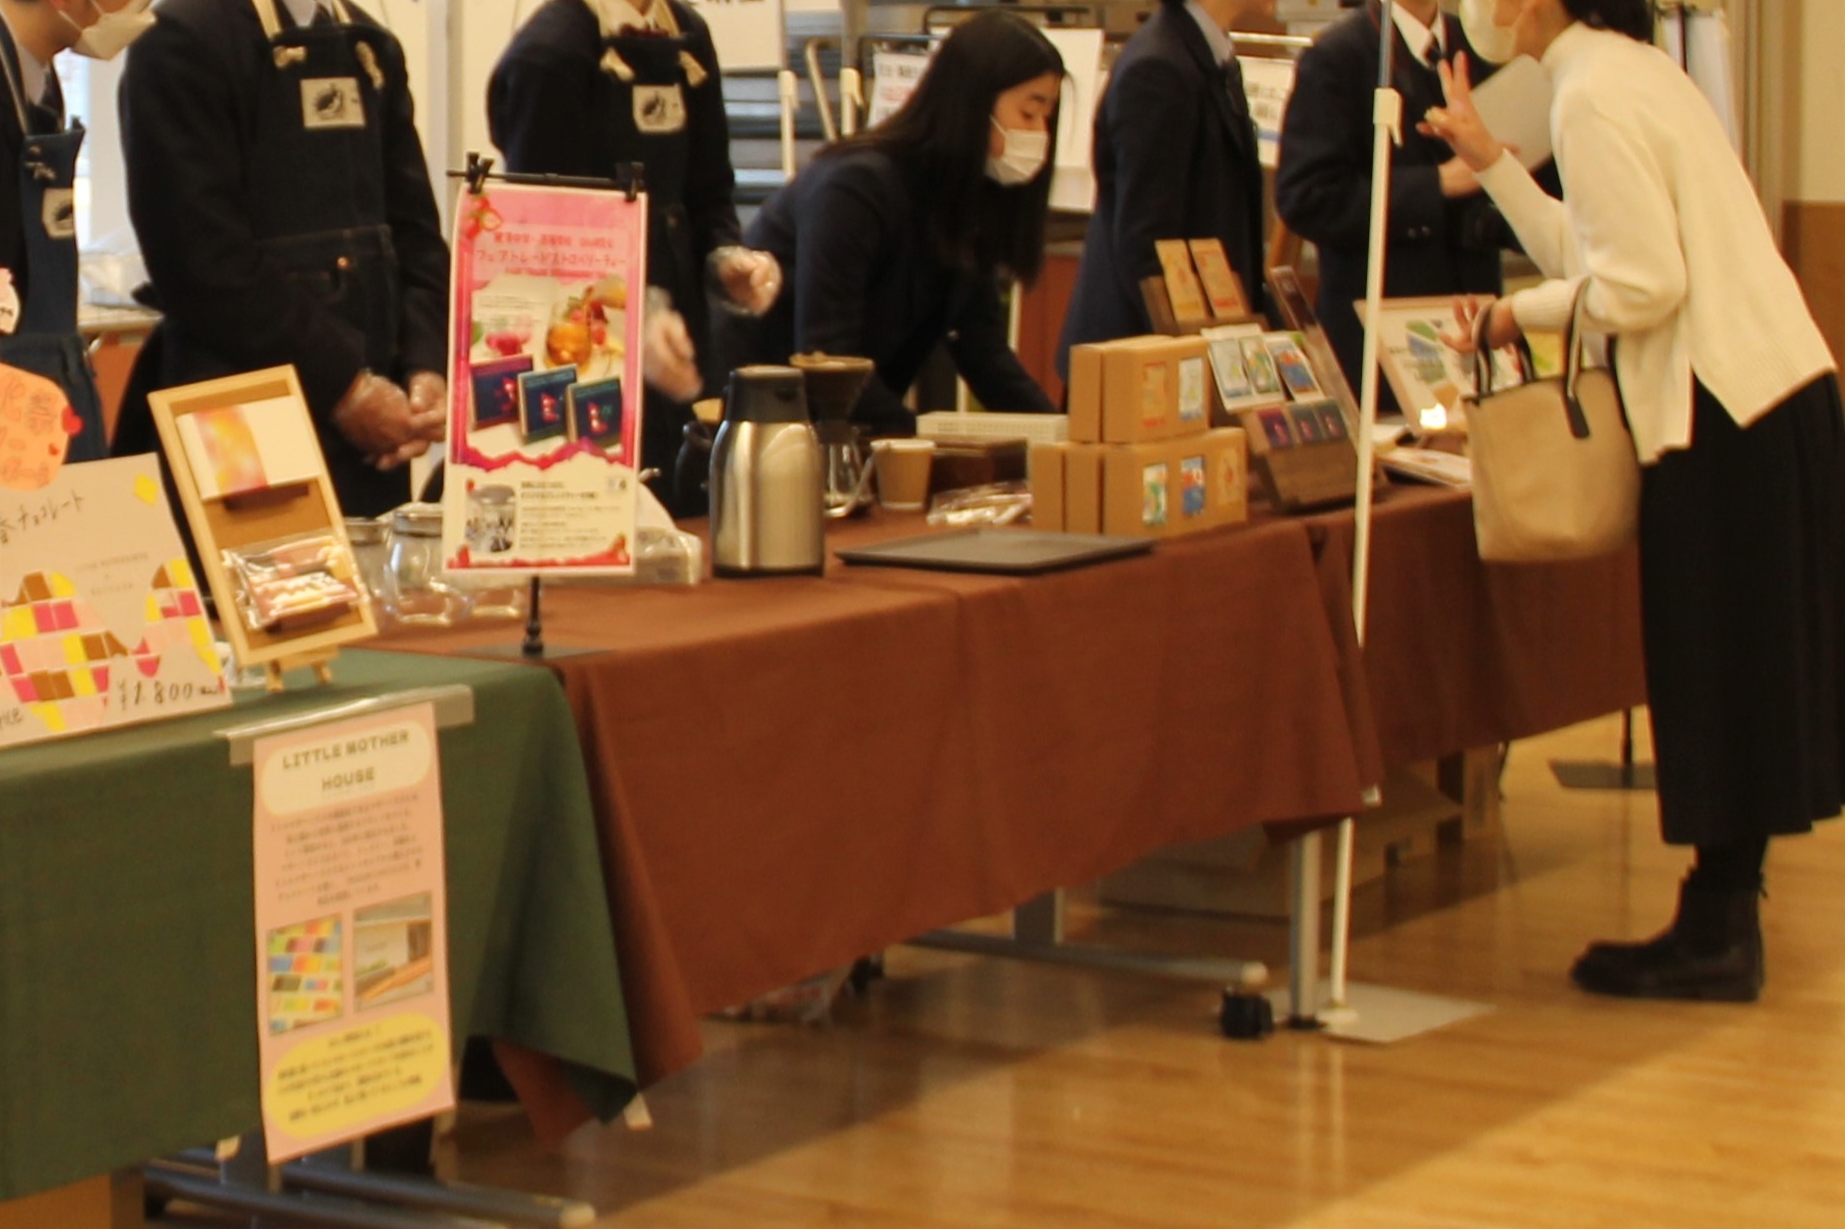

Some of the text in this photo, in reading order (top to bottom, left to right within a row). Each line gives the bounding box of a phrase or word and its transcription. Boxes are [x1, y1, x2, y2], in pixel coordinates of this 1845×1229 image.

[282, 729, 410, 770] LITTLE MOTHER
[322, 767, 375, 792] HOUSE
